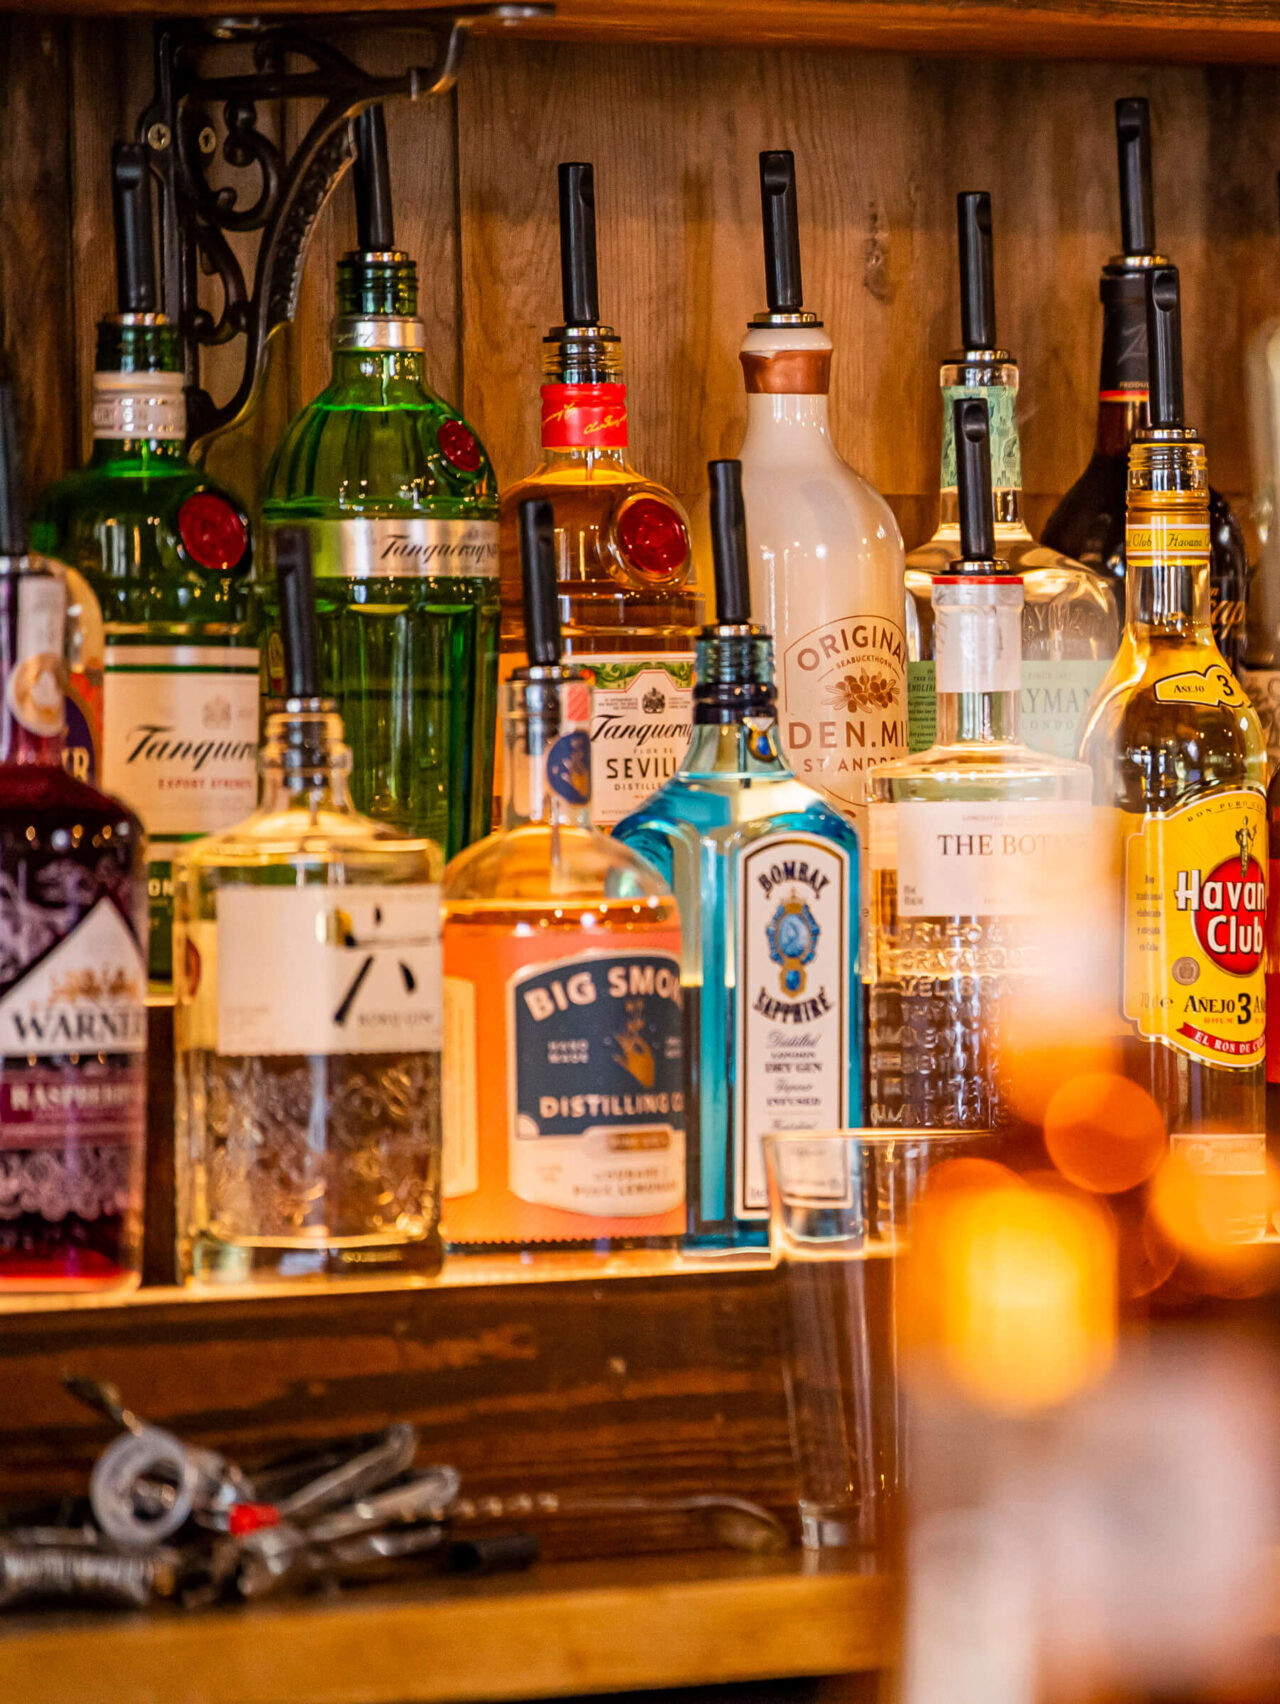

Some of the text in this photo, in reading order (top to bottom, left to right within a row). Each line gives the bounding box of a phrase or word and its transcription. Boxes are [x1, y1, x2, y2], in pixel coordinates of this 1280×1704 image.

[796, 624, 908, 676] ORIGINAL
[835, 655, 894, 670] SEABUCKTHORN
[1215, 674, 1234, 697] 3
[937, 833, 994, 856] THE
[758, 859, 830, 899] BOMBAY
[1206, 914, 1264, 955] Club
[523, 970, 597, 1022] BIG
[753, 985, 835, 1025] SAPPHIRE
[1183, 994, 1236, 1014] AÑEJO
[1236, 991, 1251, 1025] 3
[1193, 1030, 1210, 1046] EL
[1213, 1038, 1236, 1053] RON
[539, 1094, 670, 1119] DISTILLING
